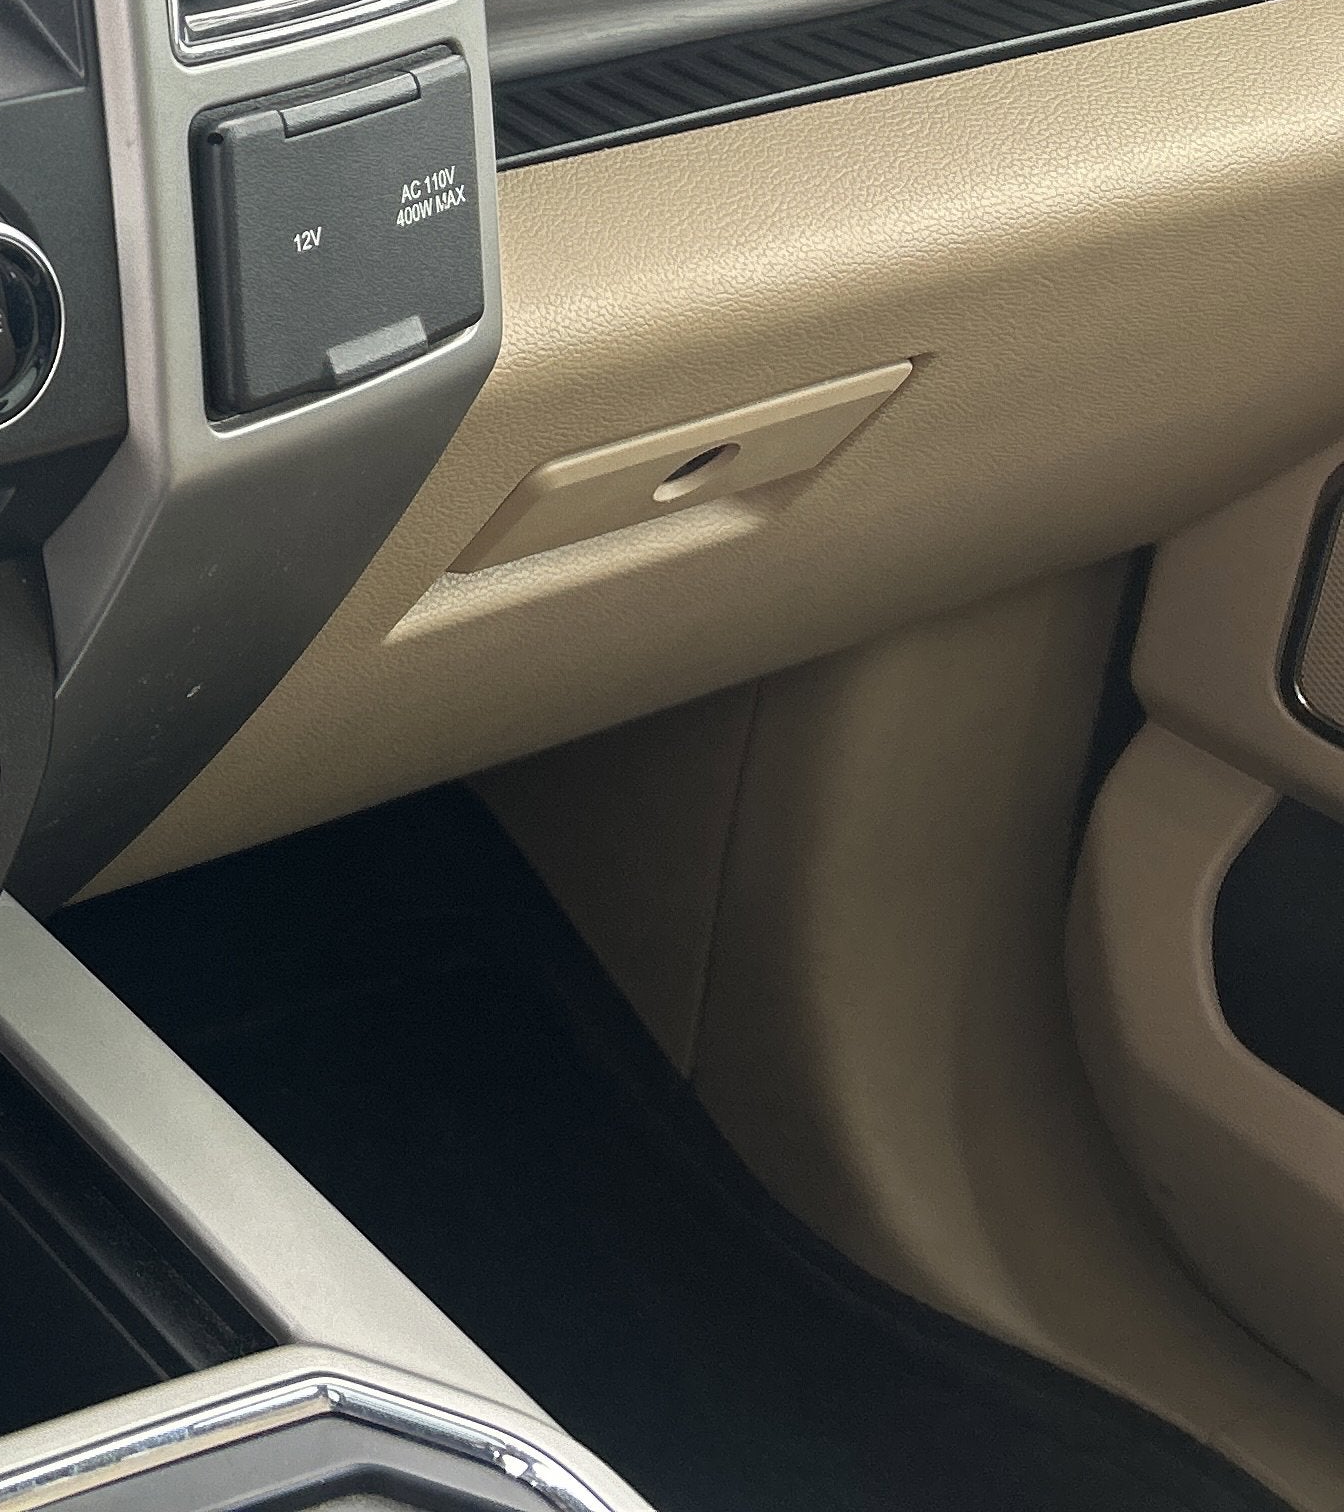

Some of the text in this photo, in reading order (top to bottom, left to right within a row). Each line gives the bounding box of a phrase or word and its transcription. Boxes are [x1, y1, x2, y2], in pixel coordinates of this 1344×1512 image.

[400, 164, 457, 204] AC 110V
[395, 184, 467, 227] 400W MAX
[292, 226, 323, 253] 12V
